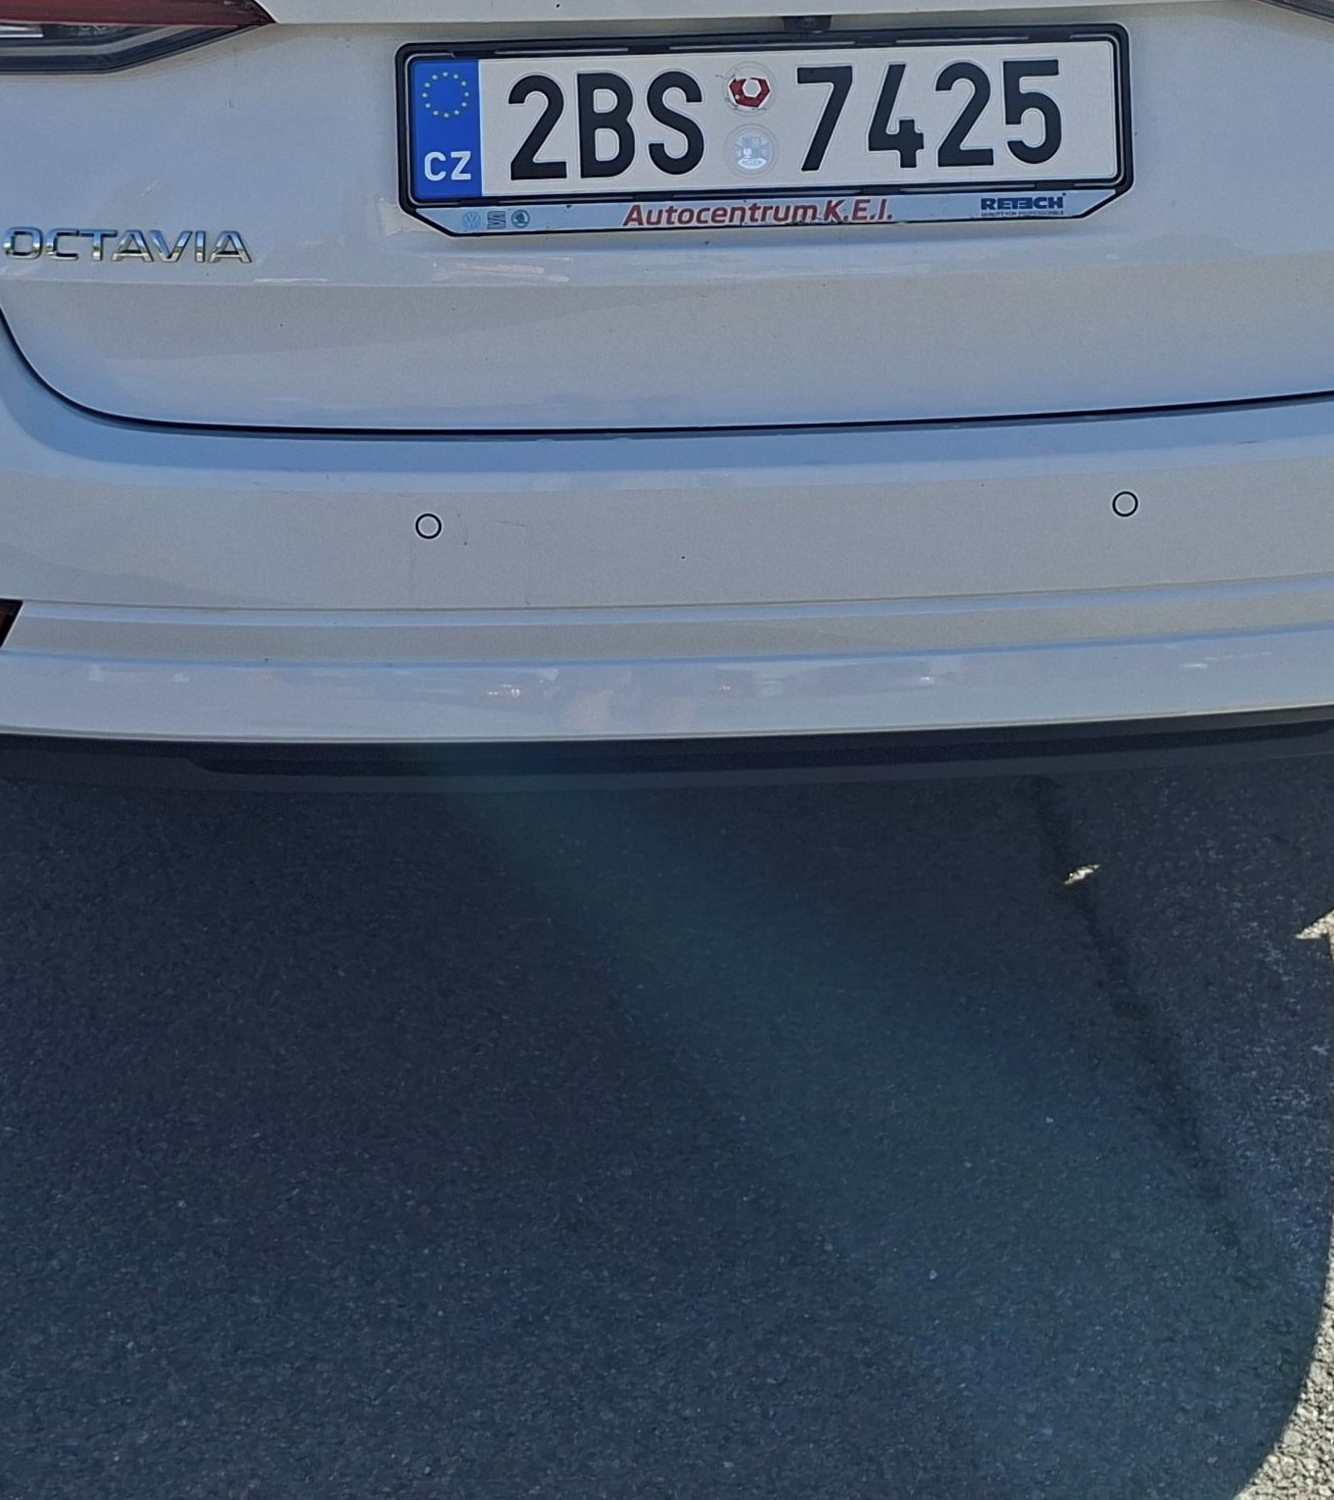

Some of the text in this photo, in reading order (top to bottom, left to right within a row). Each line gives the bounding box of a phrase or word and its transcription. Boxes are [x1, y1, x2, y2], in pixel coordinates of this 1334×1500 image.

[508, 59, 1062, 180] 2BS 7425
[424, 151, 471, 181] CZ
[623, 203, 818, 227] Autocentrum
[980, 196, 1064, 210] RETECH
[3, 227, 251, 263] OCTAVIA
